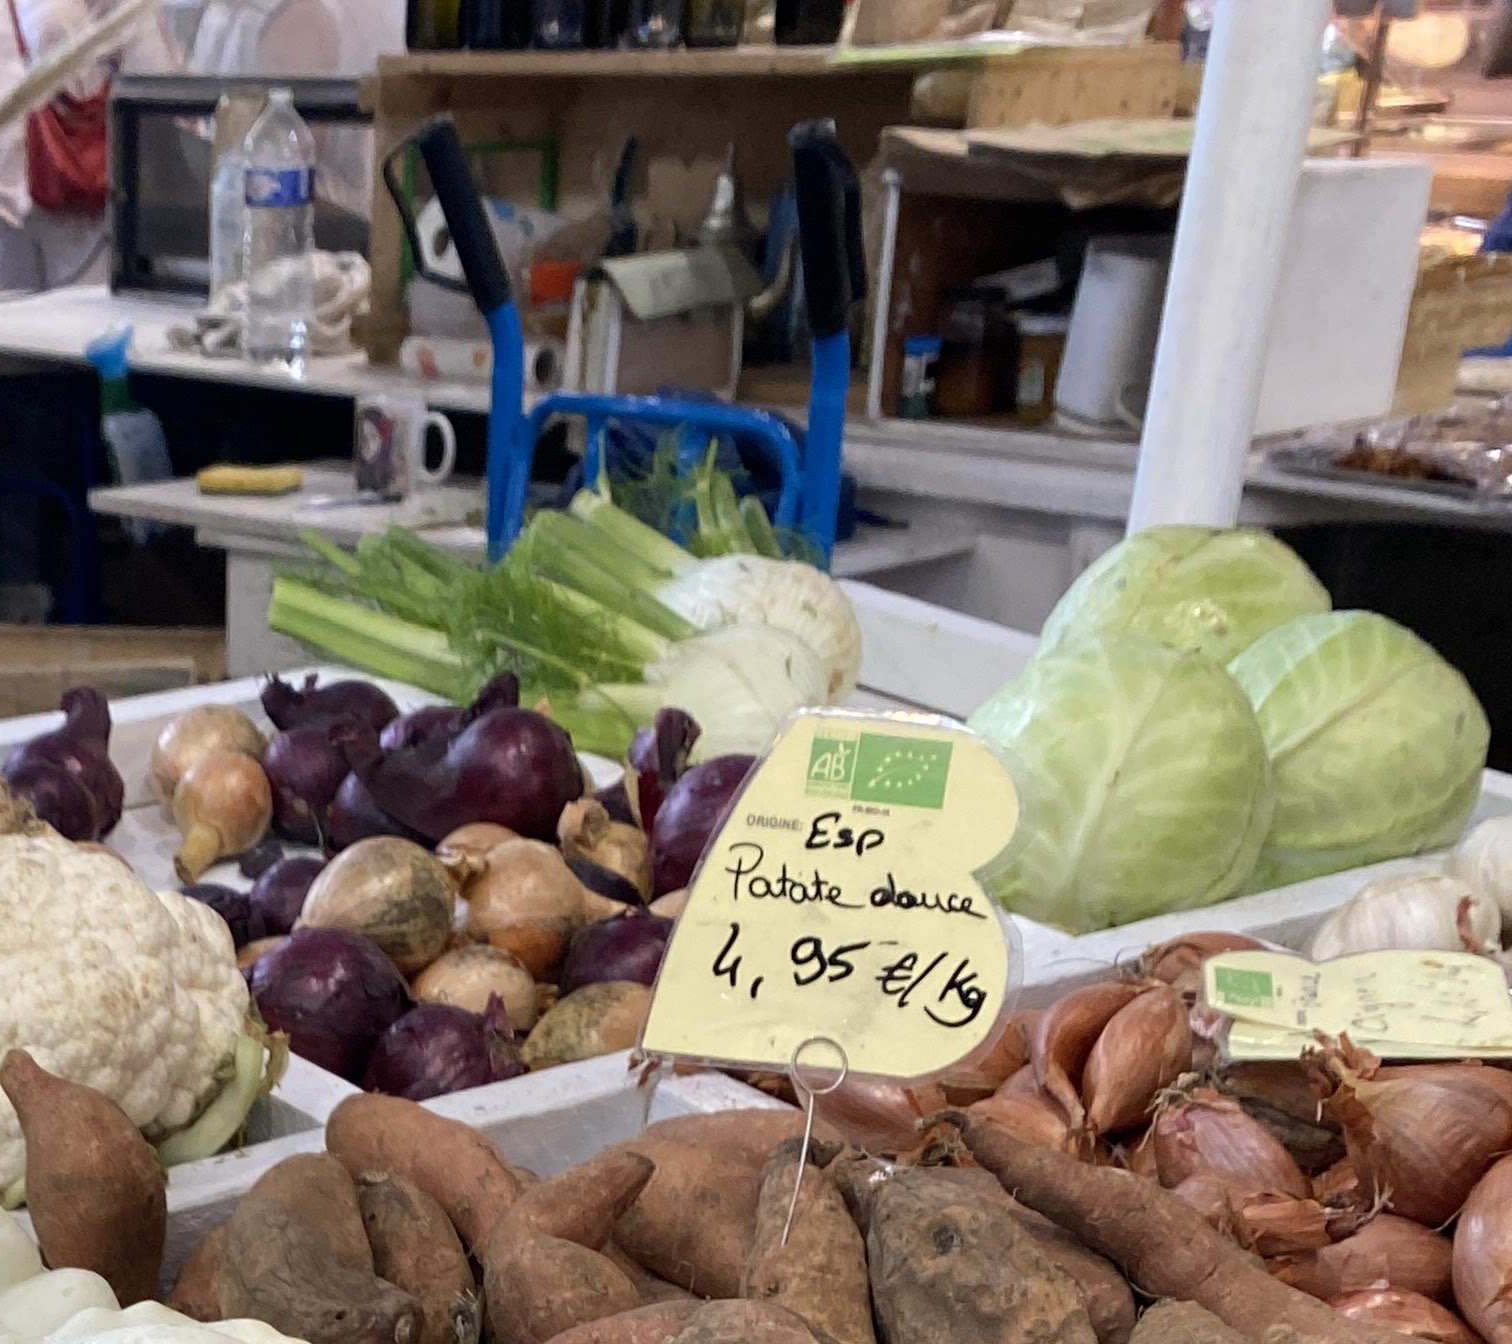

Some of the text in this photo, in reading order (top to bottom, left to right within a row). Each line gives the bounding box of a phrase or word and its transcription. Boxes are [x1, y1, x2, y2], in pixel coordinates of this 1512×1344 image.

[810, 752, 847, 779] AB
[805, 812, 886, 857] Esp
[725, 843, 988, 919] Patate douce
